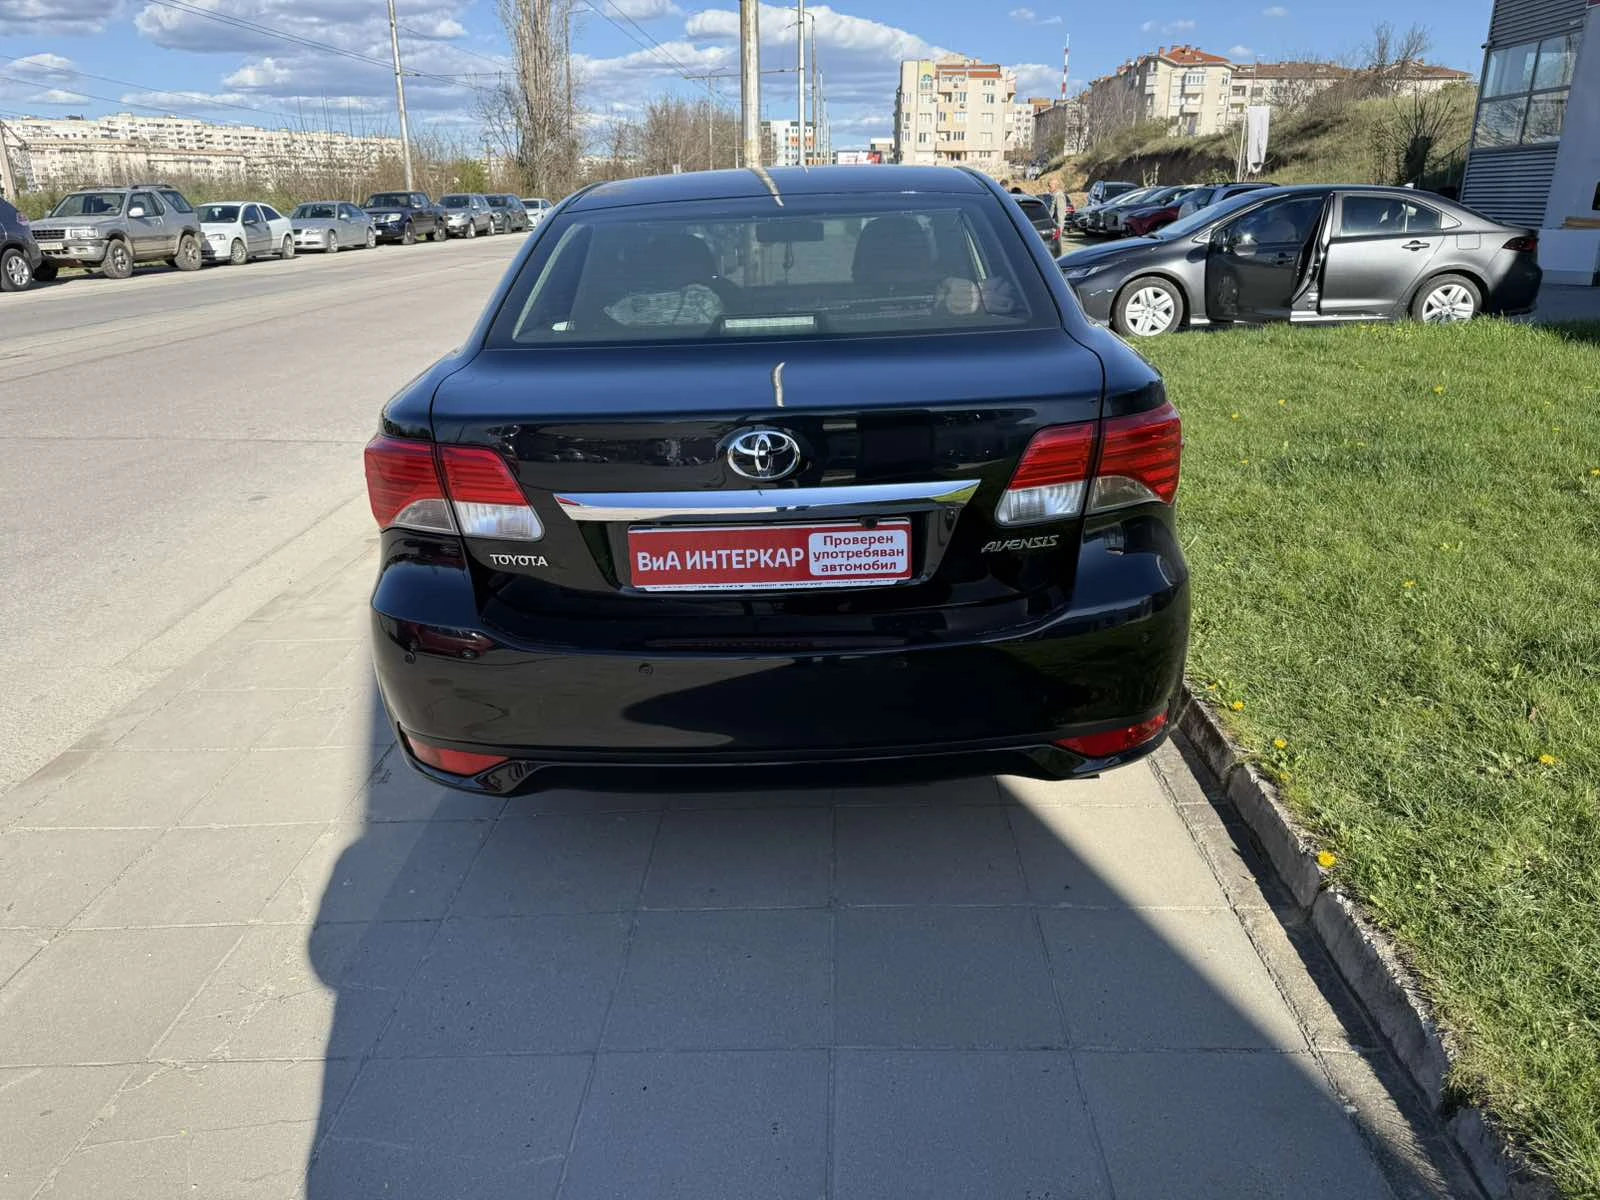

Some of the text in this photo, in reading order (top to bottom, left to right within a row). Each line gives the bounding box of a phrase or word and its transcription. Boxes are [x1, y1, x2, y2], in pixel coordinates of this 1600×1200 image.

[823, 534, 894, 548] Проверен
[981, 534, 1059, 553] AVENSIS
[489, 554, 549, 566] TOYOTA
[637, 548, 804, 571] ВиА ИНТЕРКАР
[813, 547, 905, 561] употребяван
[821, 560, 897, 573] автомобил
